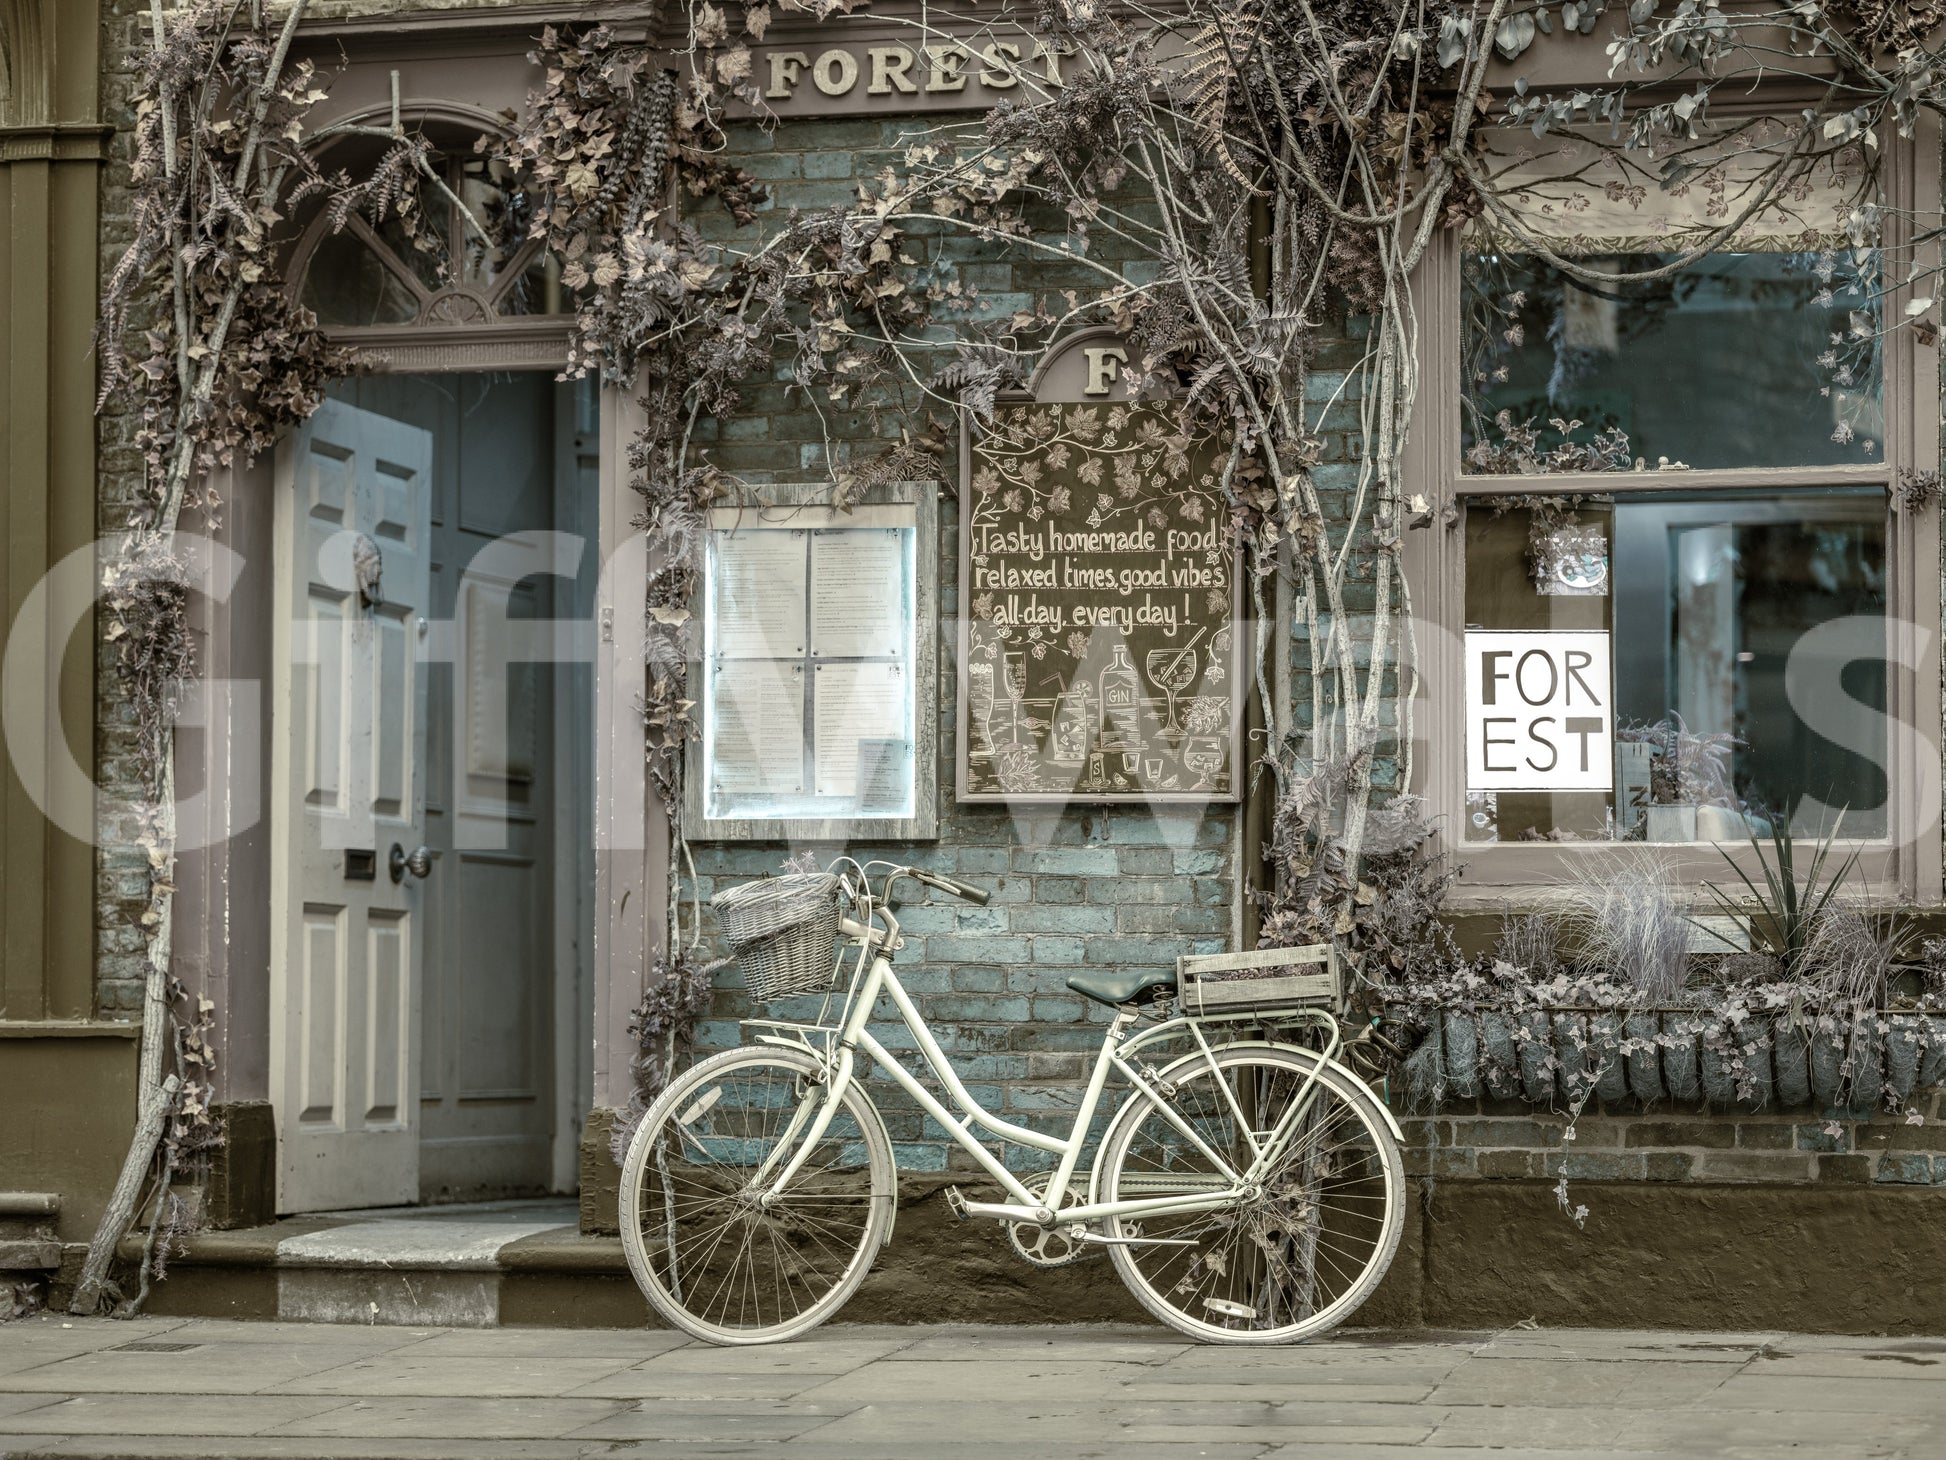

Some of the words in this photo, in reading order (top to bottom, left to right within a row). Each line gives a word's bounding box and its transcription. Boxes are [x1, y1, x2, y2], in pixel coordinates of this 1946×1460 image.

[765, 40, 1077, 98] FOREST
[1083, 348, 1129, 395] F
[973, 521, 1043, 561] Tasty
[1050, 519, 1155, 551] homemade
[1167, 518, 1218, 560] food
[975, 559, 1057, 588] relaxed
[1119, 559, 1167, 595] good
[1171, 558, 1225, 587] vibes
[1109, 689, 1129, 703] GIN
[1482, 649, 1602, 706] FOR
[1483, 716, 1604, 772] EST
